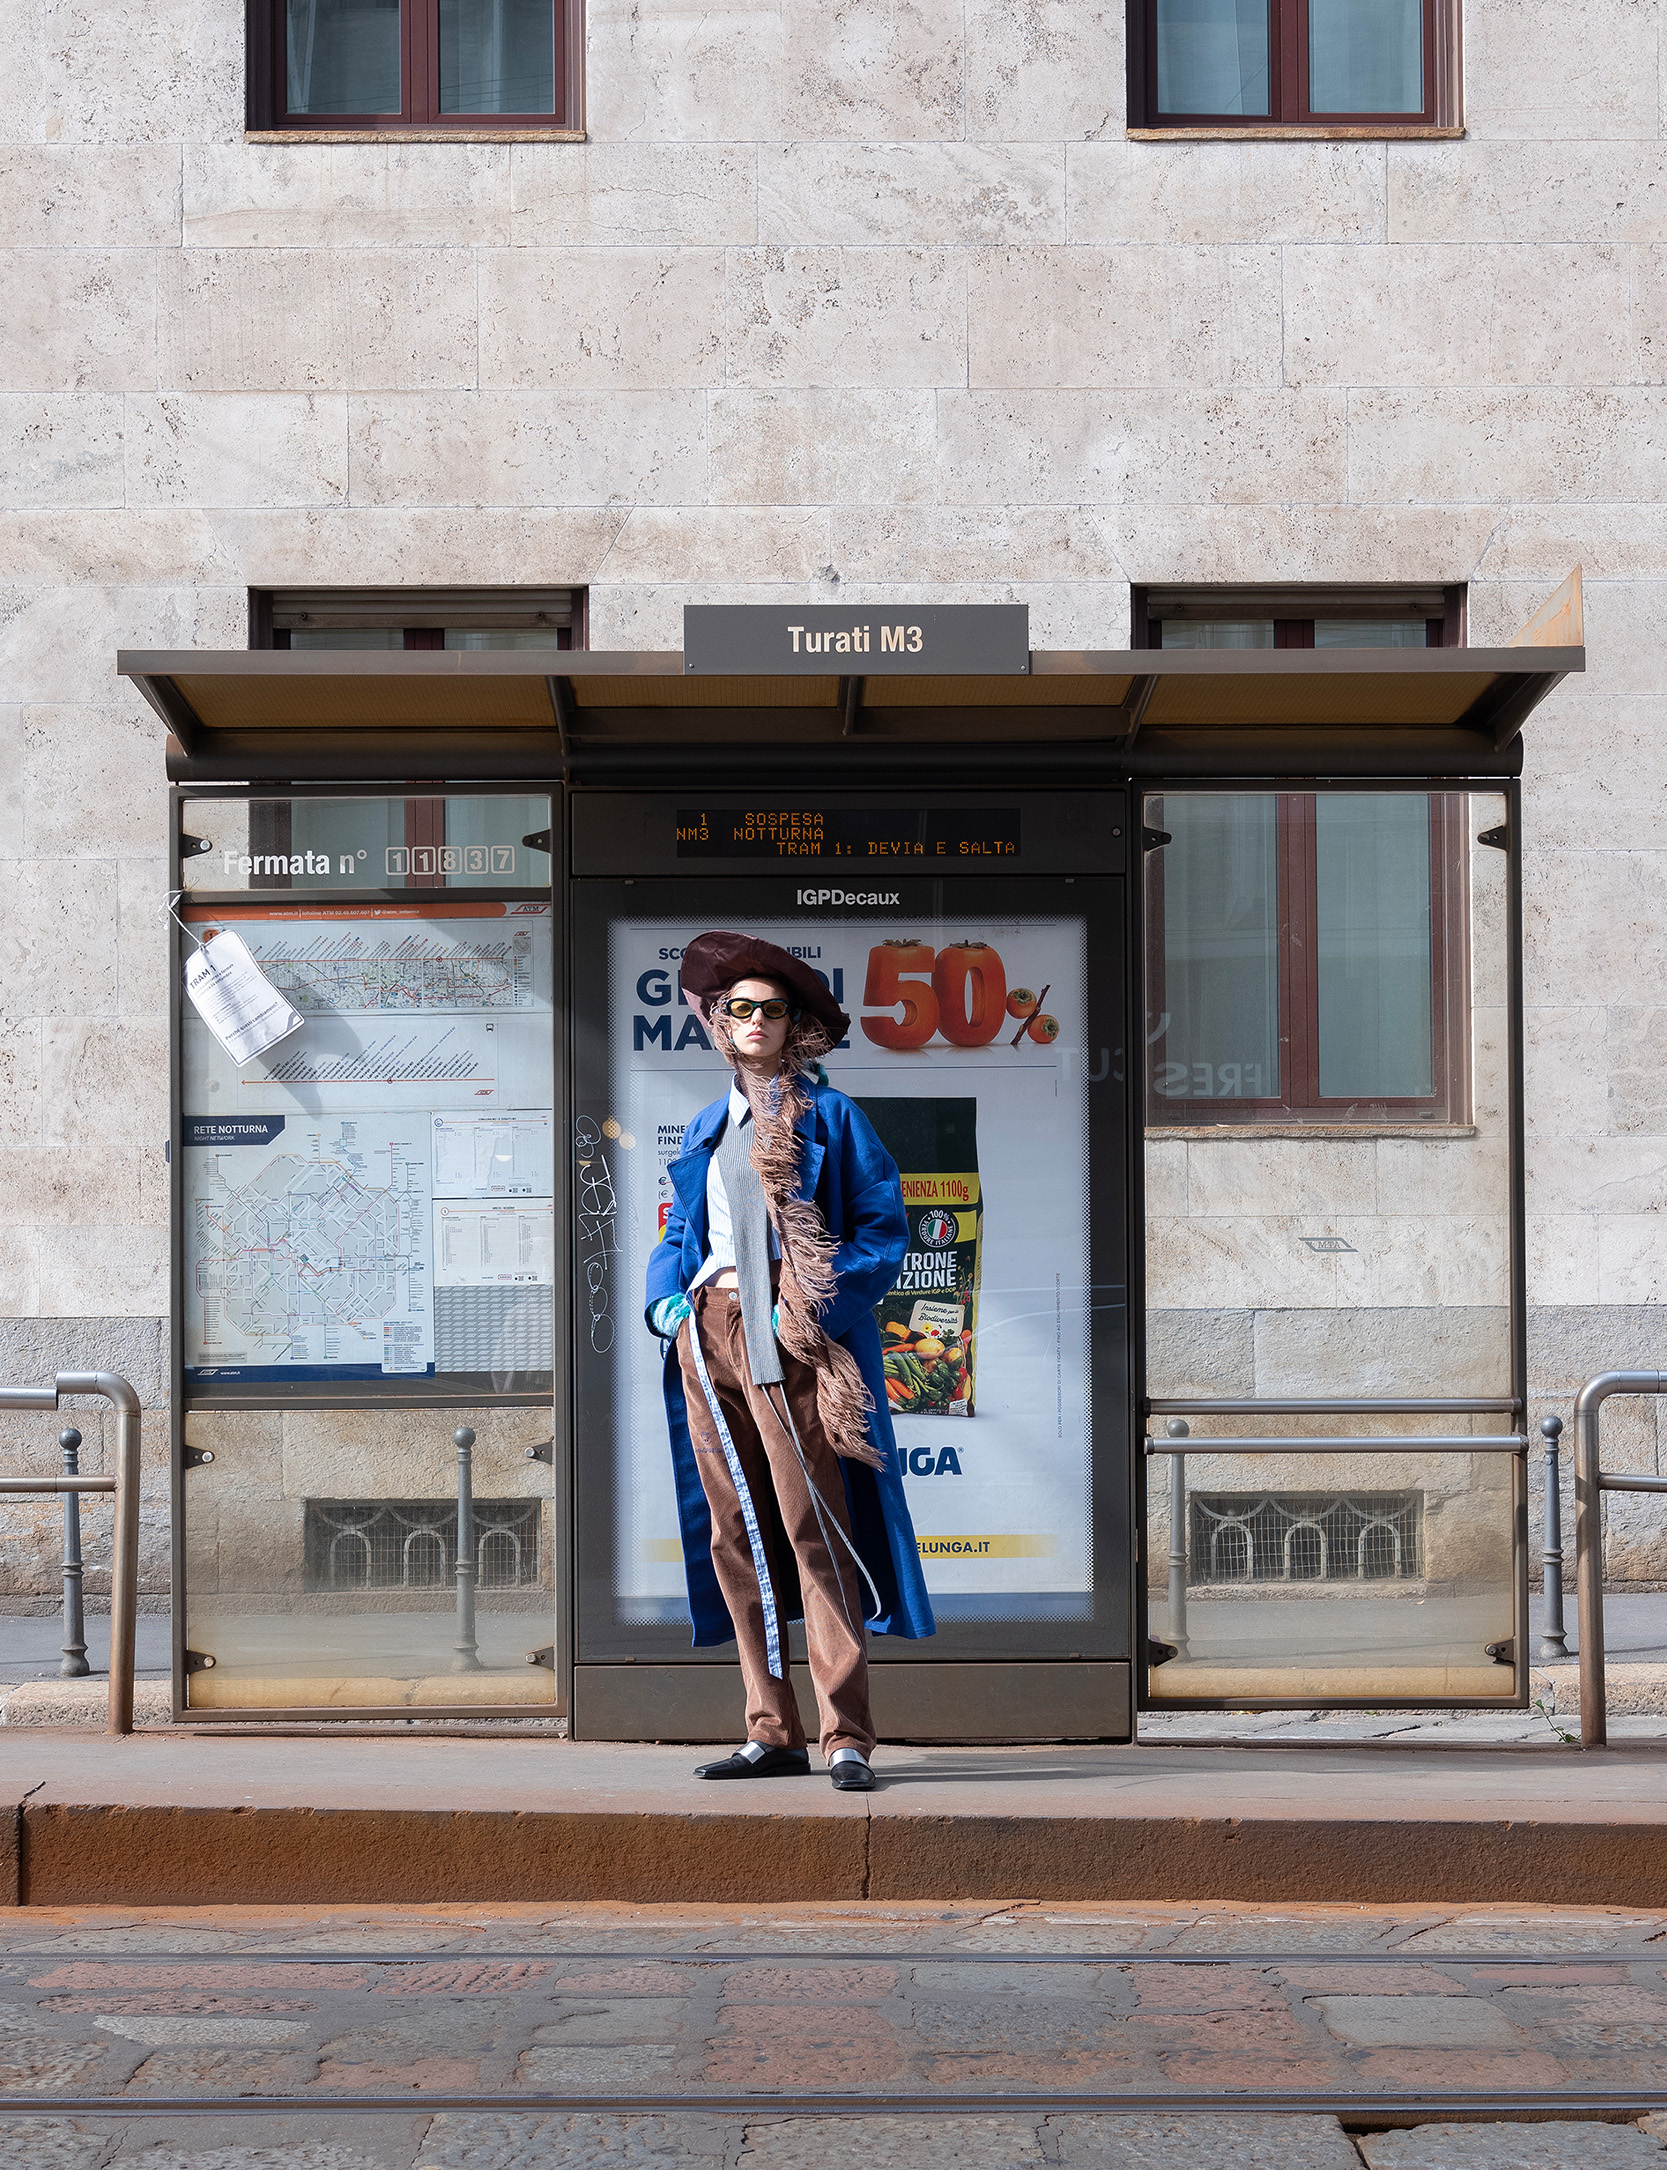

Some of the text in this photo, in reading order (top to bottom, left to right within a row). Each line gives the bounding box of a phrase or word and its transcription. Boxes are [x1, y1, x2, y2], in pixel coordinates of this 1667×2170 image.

[788, 626, 923, 653] Turati M3
[700, 813, 824, 826] 1 SOSPESA
[676, 828, 824, 841] NM3 NOTTURNA
[777, 841, 1016, 855] TRAM 1: DEVIA E SALTA
[223, 850, 330, 875] Fermata
[340, 848, 368, 874] n°
[797, 889, 900, 906] IGPDecaux
[188, 968, 212, 989] TRAM
[860, 939, 1060, 1050] 50%
[193, 1124, 269, 1135] RETE NOTTURNA
[658, 1125, 687, 1134] MINE
[658, 1136, 684, 1145] FIND
[900, 1180, 969, 1201] ENIENZA 1100g
[930, 1209, 950, 1221] 100%
[903, 1251, 958, 1271] TRONE
[916, 1541, 991, 1553] ELUNGA.IT
